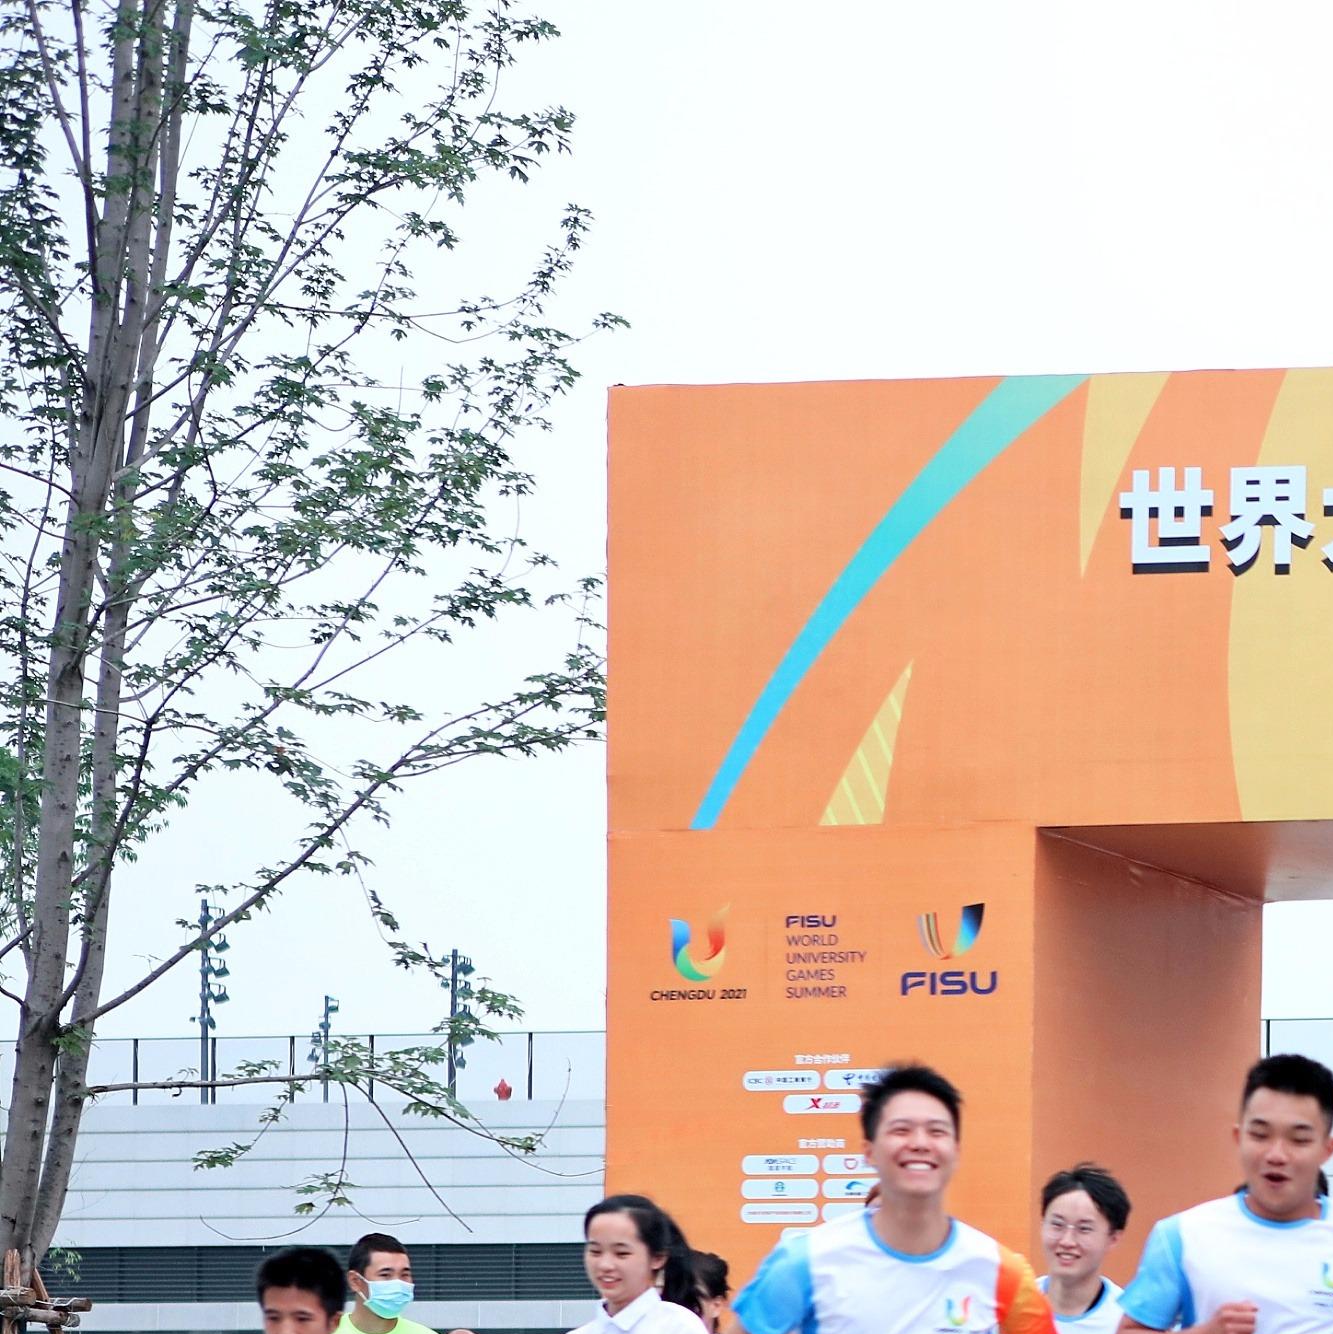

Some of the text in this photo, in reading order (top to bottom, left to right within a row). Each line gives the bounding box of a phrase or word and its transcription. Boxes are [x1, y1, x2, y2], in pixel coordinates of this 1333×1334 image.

[785, 915, 837, 929] FISU
[786, 934, 838, 947] WORLD
[786, 951, 867, 964] UNIVERSITY
[786, 969, 835, 982] GAMES
[901, 971, 998, 996] FISU
[650, 988, 748, 1001] CHENGDU 2021
[786, 986, 847, 999] SUMMER
